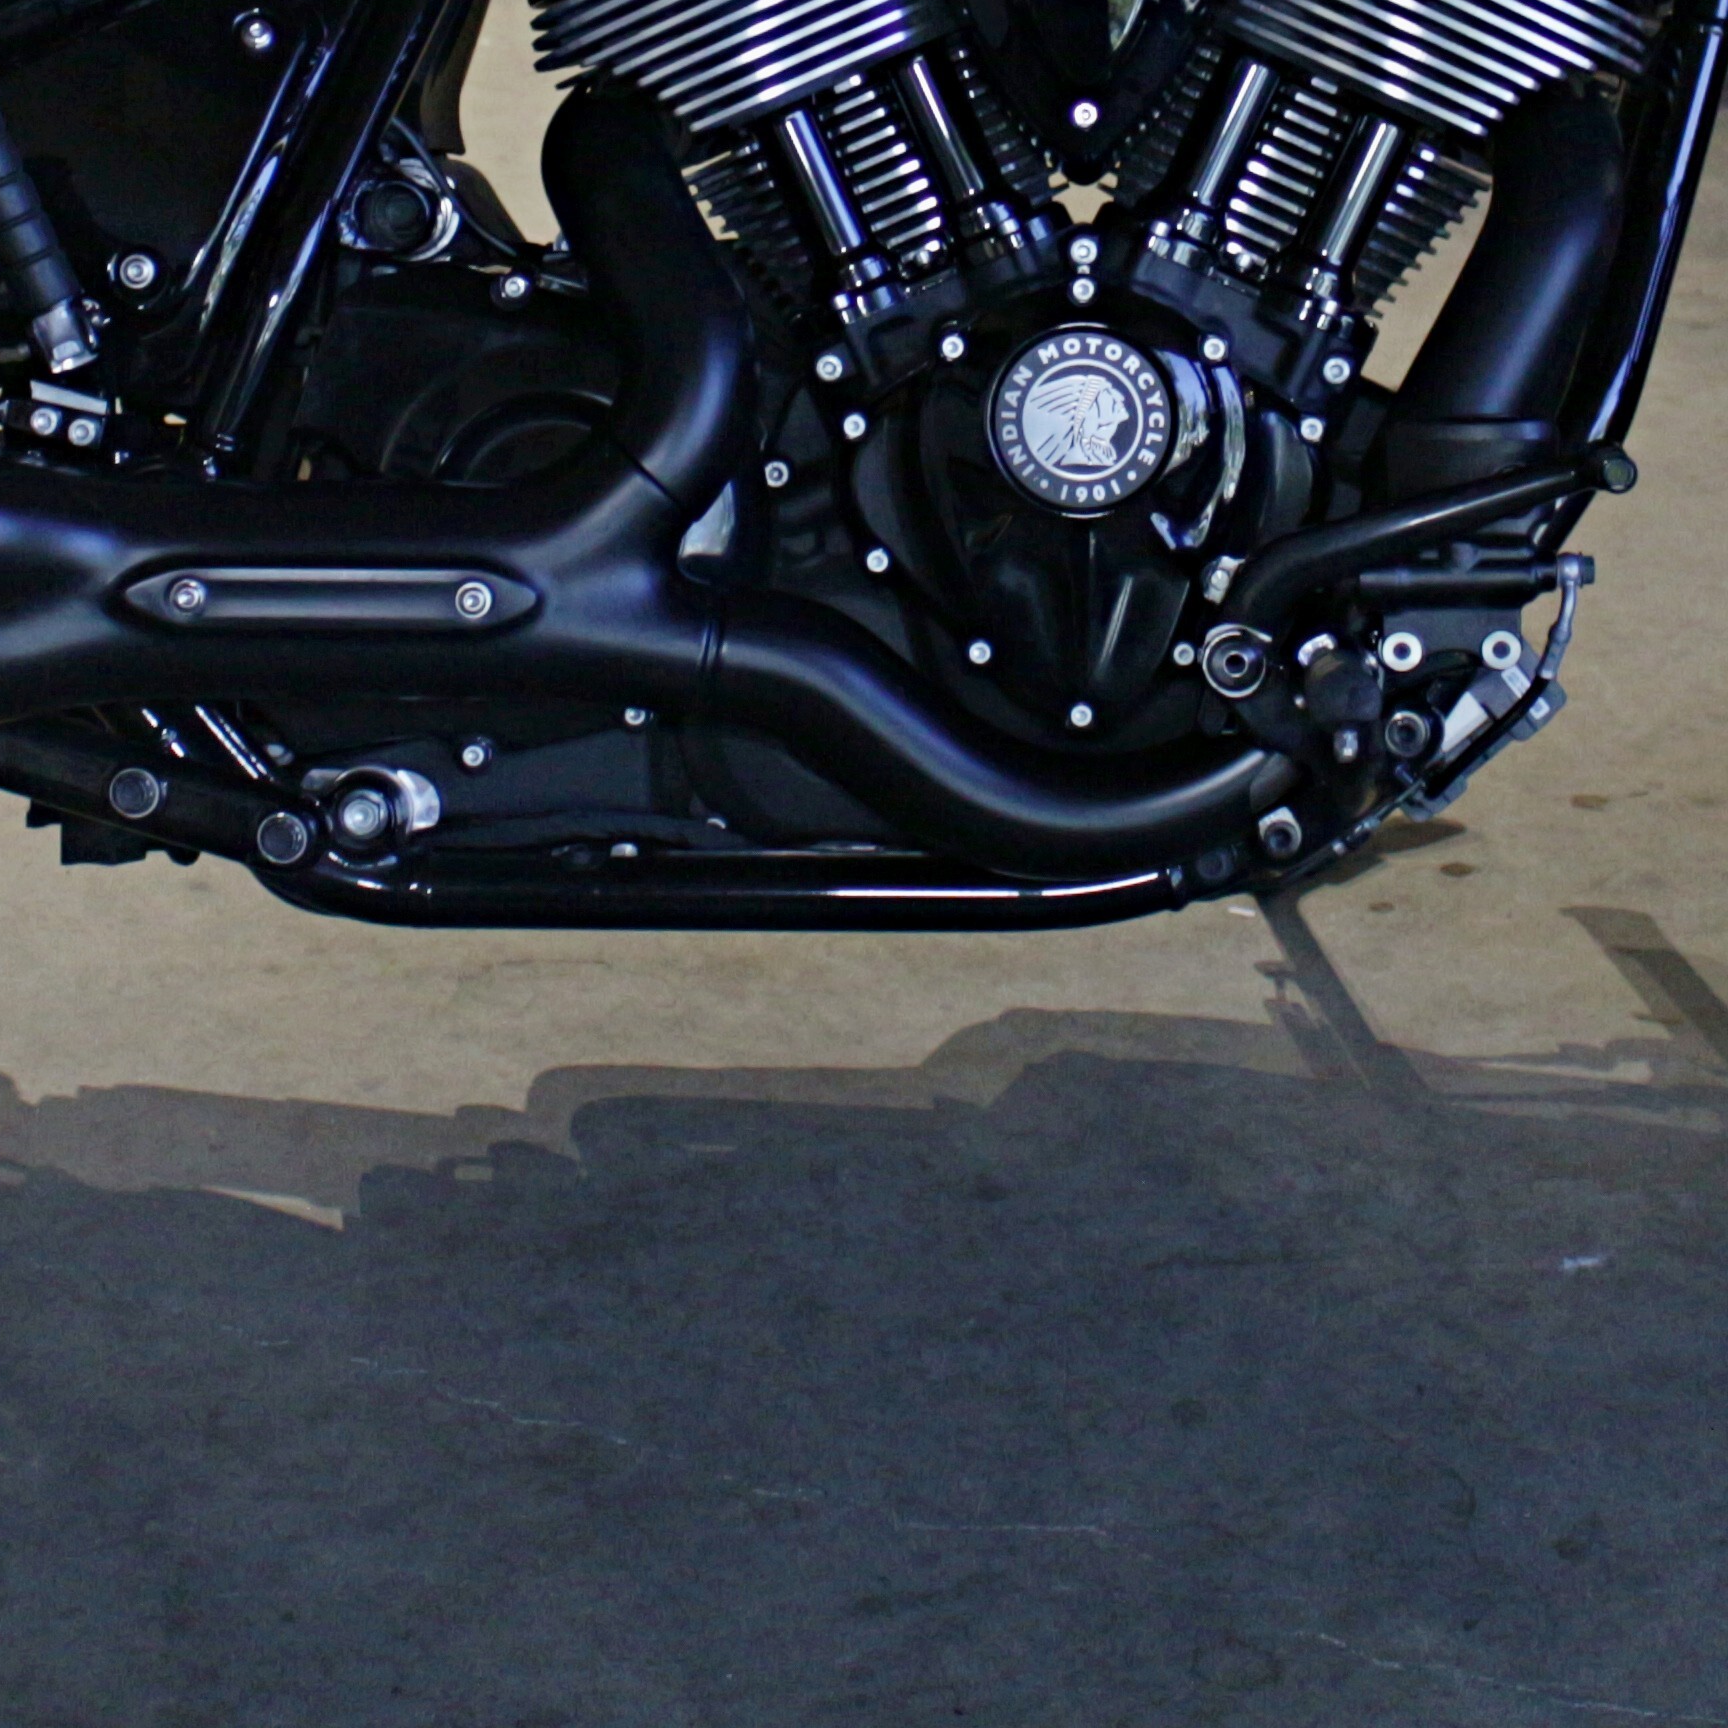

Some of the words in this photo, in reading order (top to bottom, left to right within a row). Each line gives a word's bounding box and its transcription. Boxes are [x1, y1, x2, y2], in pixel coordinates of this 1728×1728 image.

[1001, 366, 1035, 479] INDIAN
[1037, 336, 1166, 467] MOTORCYCLE
[1060, 479, 1121, 504] 1901
